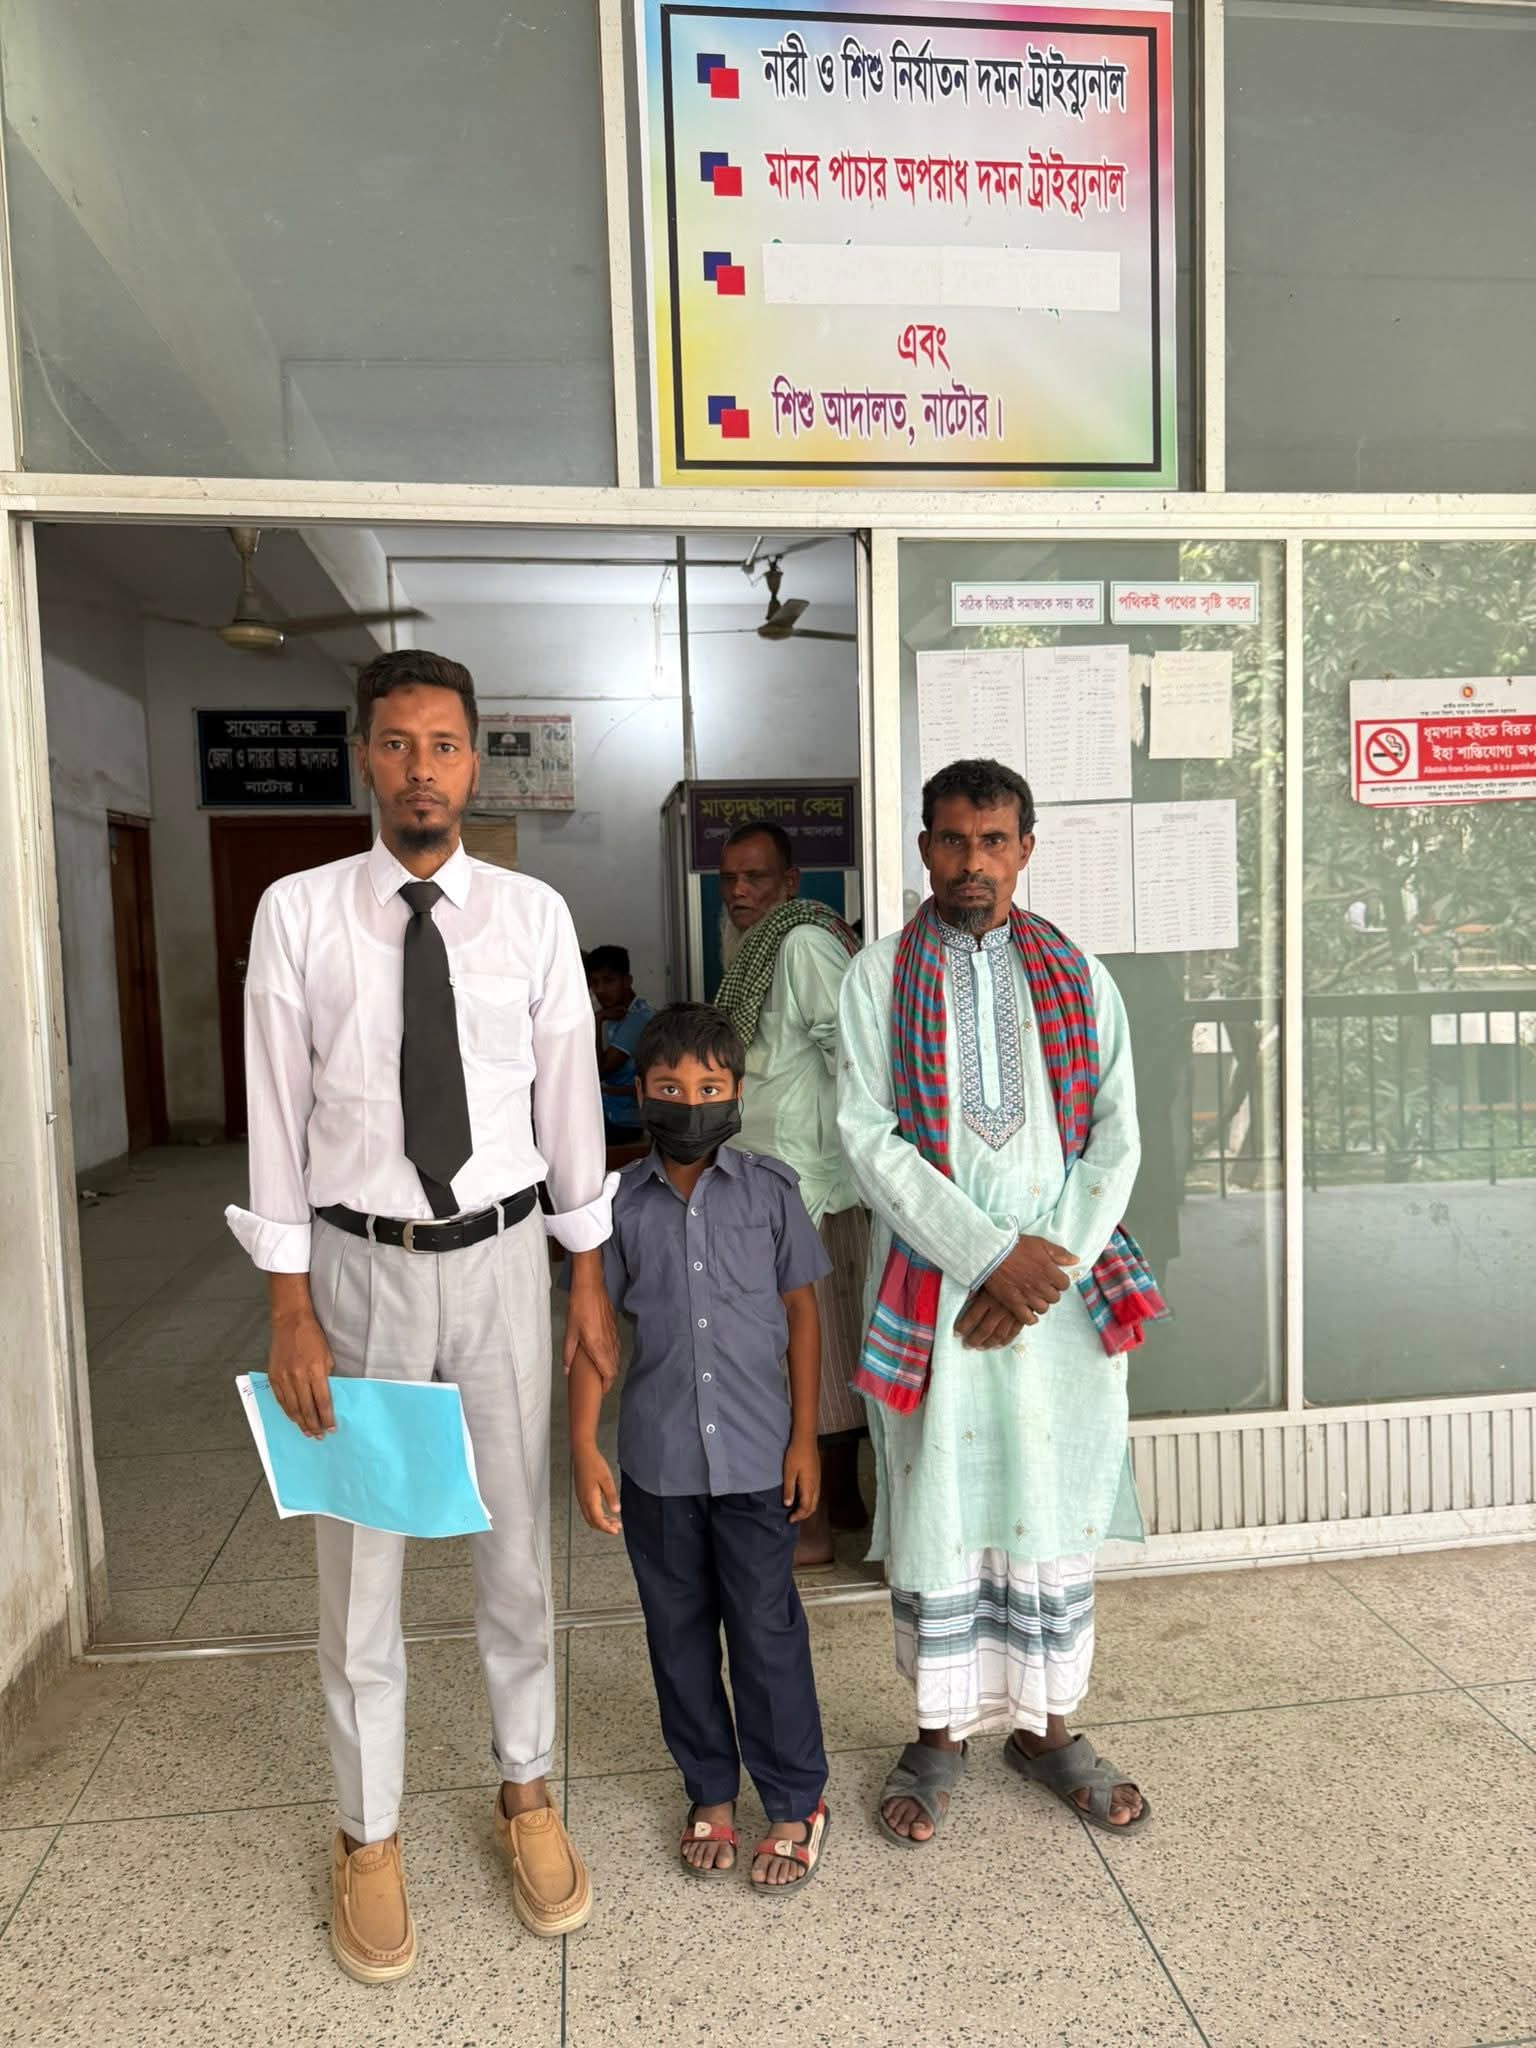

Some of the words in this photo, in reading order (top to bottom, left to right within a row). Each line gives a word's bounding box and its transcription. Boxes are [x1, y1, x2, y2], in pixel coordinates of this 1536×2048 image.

[761, 33, 807, 98] নারী
[818, 52, 834, 93] ও
[842, 39, 884, 101] শিশু
[890, 39, 968, 104] নির্যাতন
[975, 59, 1023, 107] দমন
[1027, 46, 1127, 118] ট্রাইব্যুনাল
[763, 150, 820, 199] মানব
[828, 152, 888, 201] পাচার
[894, 154, 969, 206] অপরাধ
[975, 159, 1023, 207] দমন
[1027, 148, 1127, 218] ট্রাইব্যুনাল
[897, 323, 951, 370] এবং
[771, 377, 814, 433] শিশু
[821, 385, 916, 445] আদালত,
[960, 595, 983, 610] সঠিক
[1017, 597, 1053, 611] সমাজকে
[1076, 597, 1095, 610] করে
[1118, 592, 1160, 611] পথিকই
[1164, 596, 1196, 611] পথের
[1200, 592, 1221, 616] সৃষ্টি
[1226, 595, 1251, 611] করে
[1423, 726, 1462, 744] ধূমপান
[1465, 722, 1499, 739] হইতে
[1501, 720, 1533, 737] বিরত
[1431, 744, 1454, 761] ইহা
[1456, 742, 1513, 760] শাস্তিযোগ্য
[1516, 743, 1536, 758] অপ
